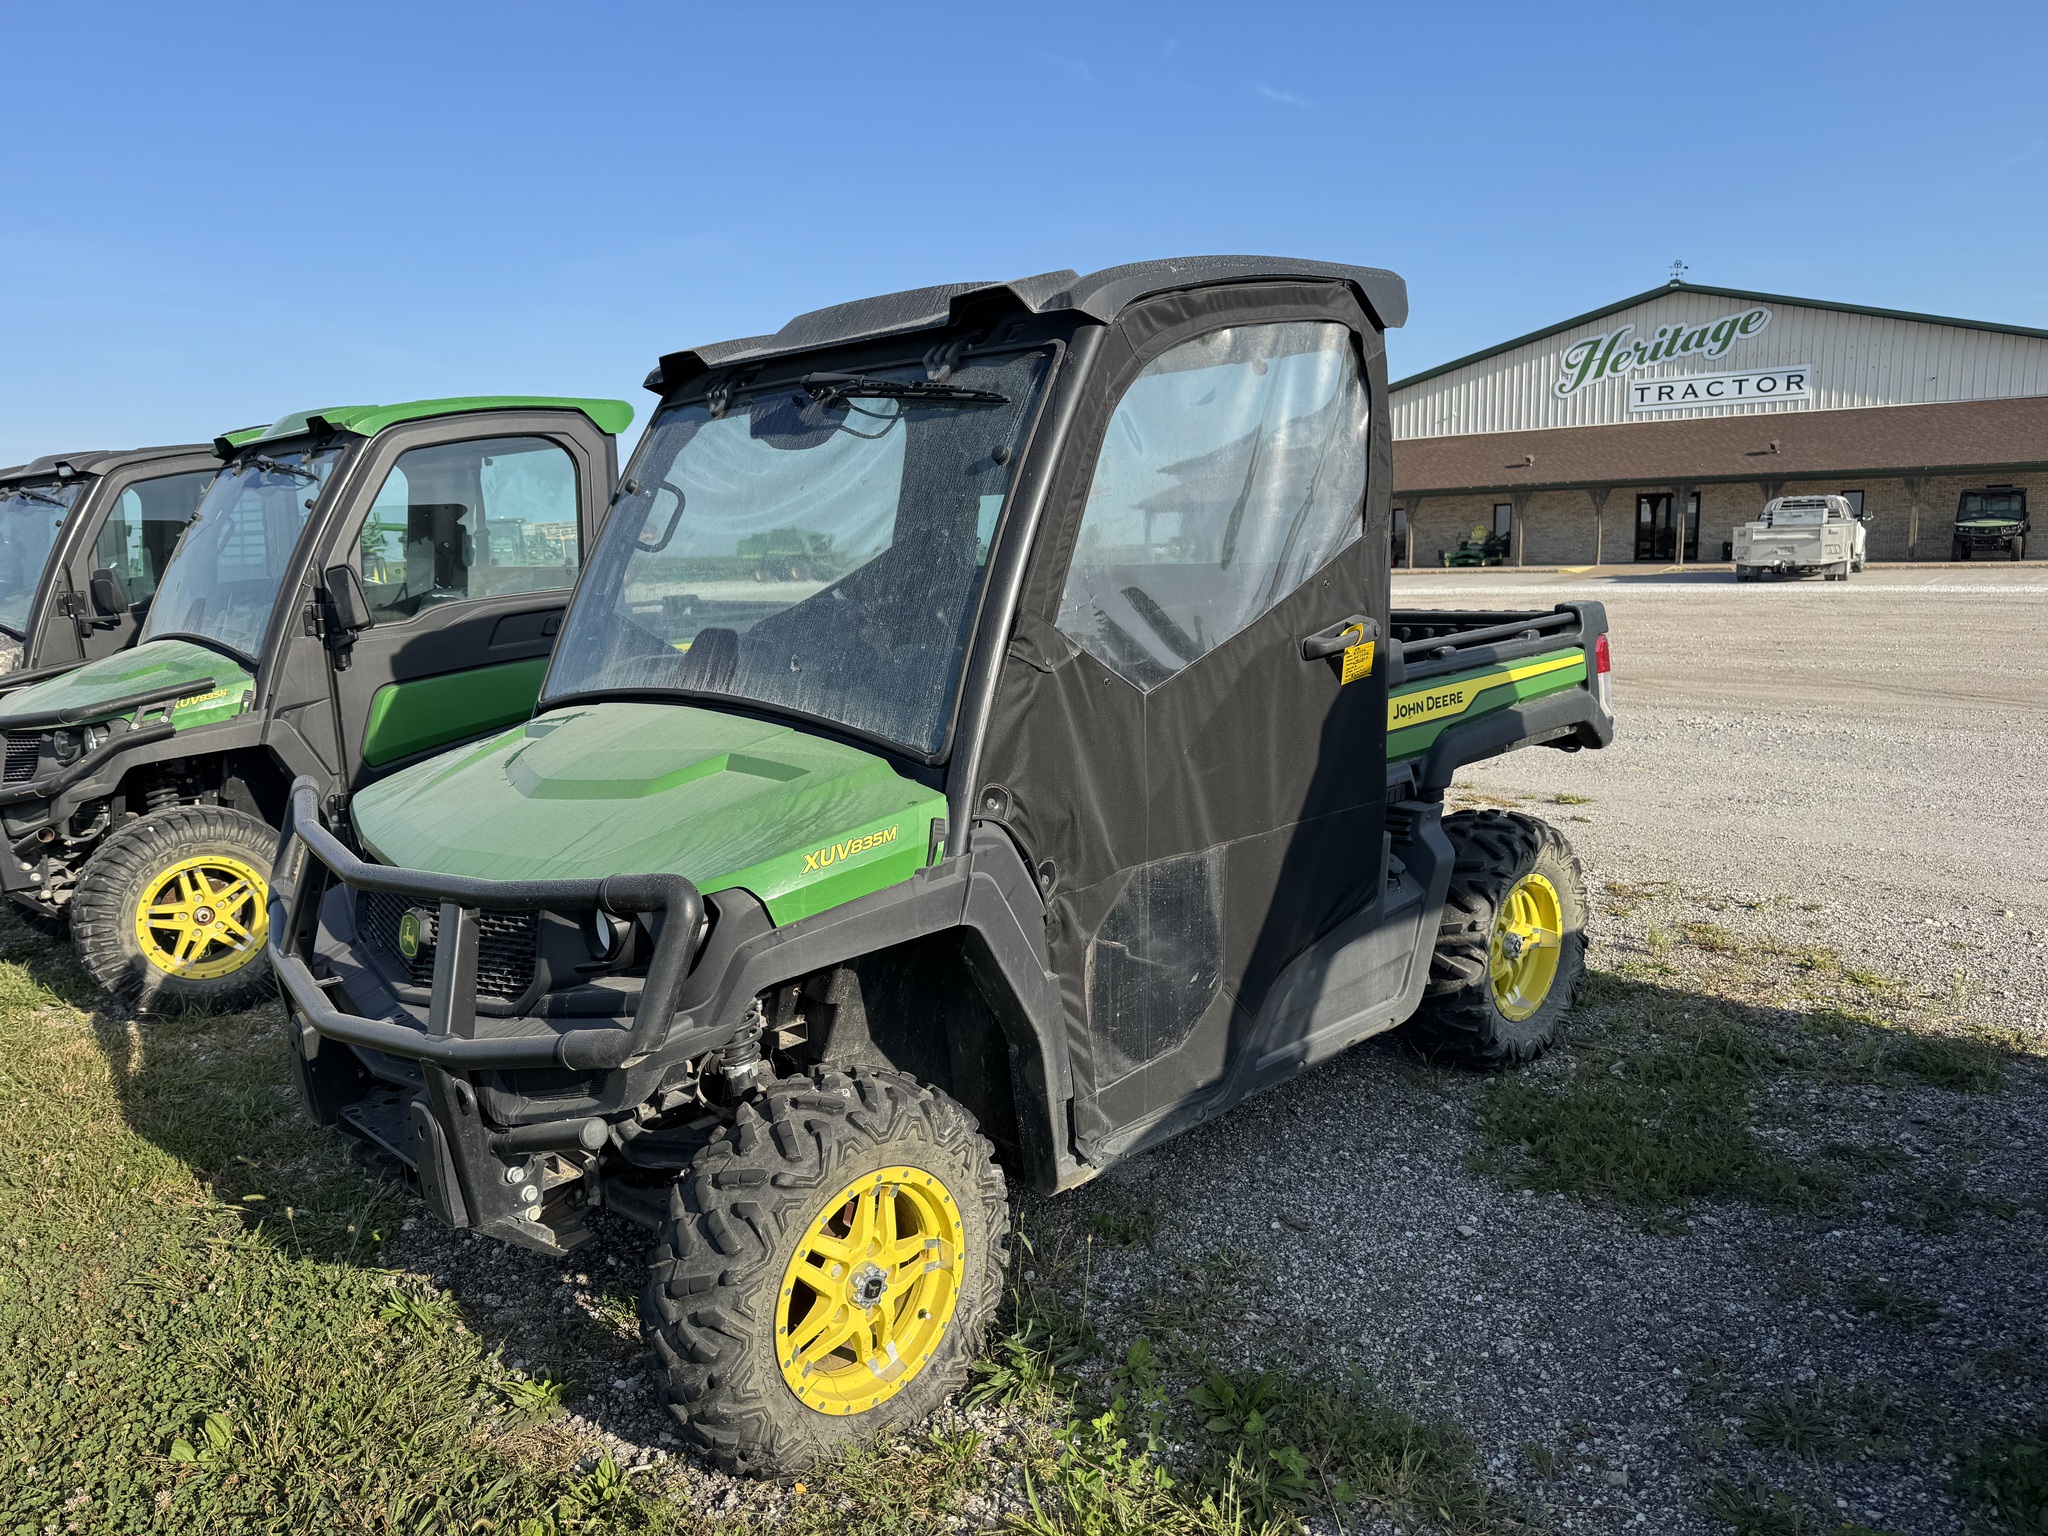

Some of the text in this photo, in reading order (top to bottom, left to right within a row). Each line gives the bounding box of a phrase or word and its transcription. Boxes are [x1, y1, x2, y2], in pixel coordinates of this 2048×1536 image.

[1558, 310, 1768, 394] Heritage
[1634, 374, 1805, 403] TRACTOR
[1393, 691, 1463, 720] JOHN DEERE
[801, 825, 897, 875] XUV835M
